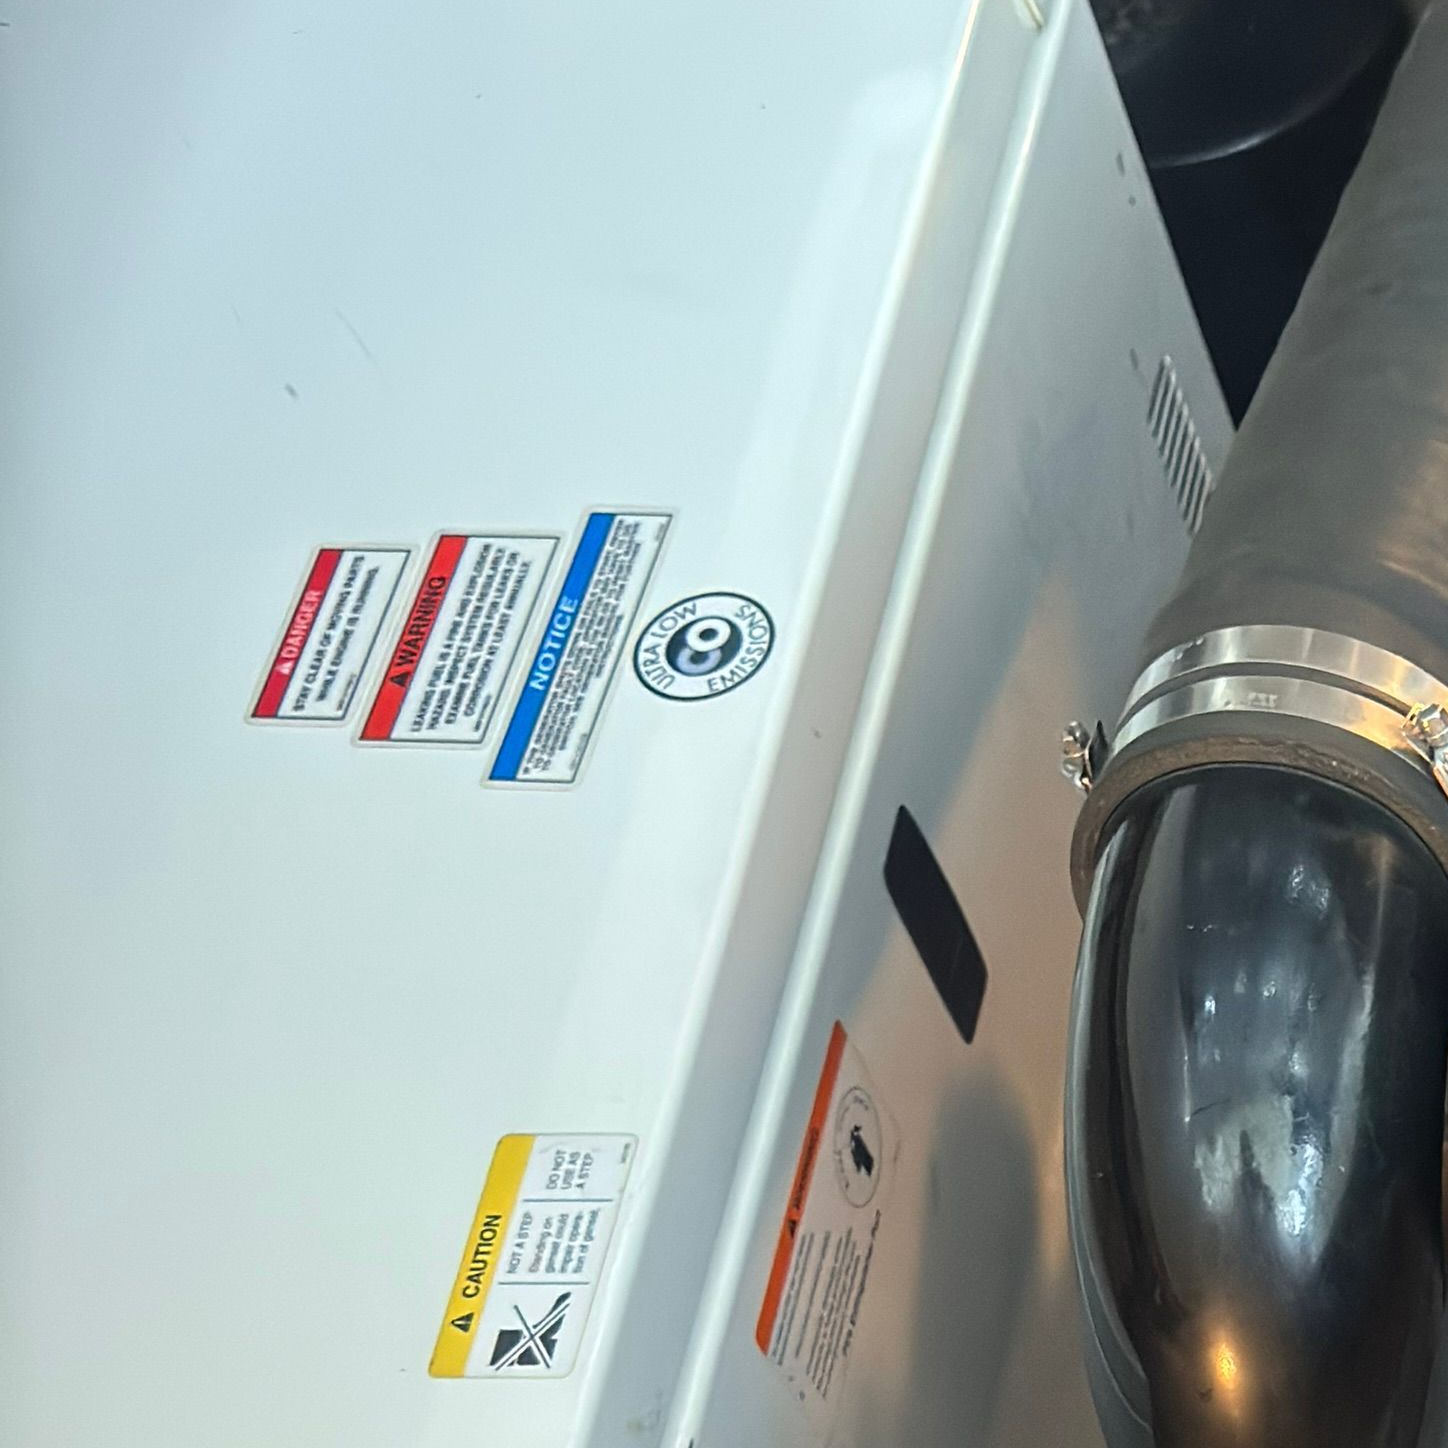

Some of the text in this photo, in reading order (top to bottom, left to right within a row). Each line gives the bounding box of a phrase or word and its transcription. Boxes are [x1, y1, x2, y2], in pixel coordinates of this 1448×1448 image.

[279, 590, 323, 657] DANGER
[395, 576, 448, 665] WARNING
[528, 595, 580, 690] NOTICE
[643, 602, 697, 690] ULTRA LOW
[707, 604, 768, 692] EMISSIONS
[545, 1149, 567, 1189] DO NOT
[560, 1151, 580, 1189] USE AS
[578, 1153, 594, 1179] STEP
[460, 1214, 502, 1298] CAUTION
[506, 1211, 535, 1273] NOT A STEP
[527, 1216, 554, 1272] Standing on
